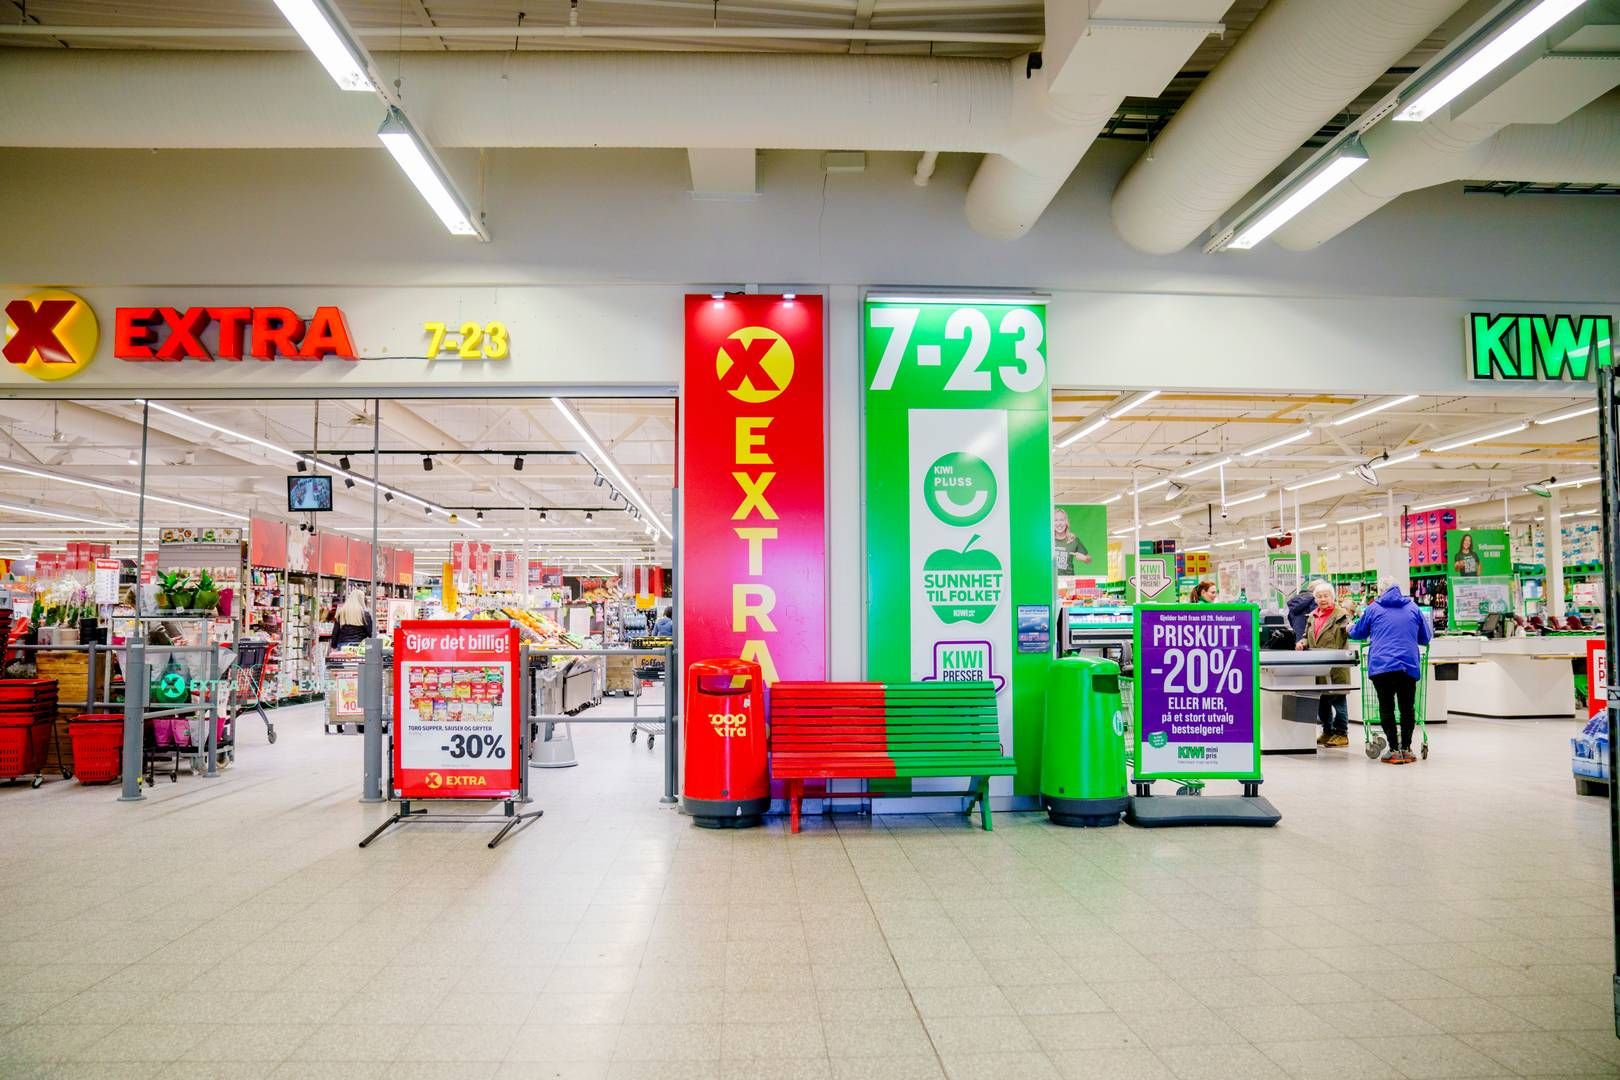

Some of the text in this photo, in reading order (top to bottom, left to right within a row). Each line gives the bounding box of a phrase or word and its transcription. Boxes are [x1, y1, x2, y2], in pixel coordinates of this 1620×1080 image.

[114, 306, 361, 361] EXTRA
[424, 321, 509, 360] 7-23
[869, 307, 1046, 392] 7-23
[1470, 313, 1613, 380] KIWI
[934, 466, 954, 474] KIWI
[934, 477, 973, 486] PLUSS
[924, 574, 1002, 588] SUNNHET
[926, 590, 1001, 601] TIL FOLKET
[1153, 624, 1242, 647] PRISKUTT
[406, 634, 509, 653] Gjør det billig!
[942, 650, 983, 668] KIWI
[943, 669, 983, 682] PRESSER
[1151, 648, 1243, 694] -20%
[190, 680, 240, 691] EXTRA
[1168, 697, 1227, 712] ELLER MER,
[1162, 712, 1234, 725] på et stort utvalg
[1172, 724, 1224, 736] bestselgere!
[441, 734, 506, 759] -30%
[1177, 746, 1205, 759] KIWI
[446, 775, 487, 786] EXTRA
